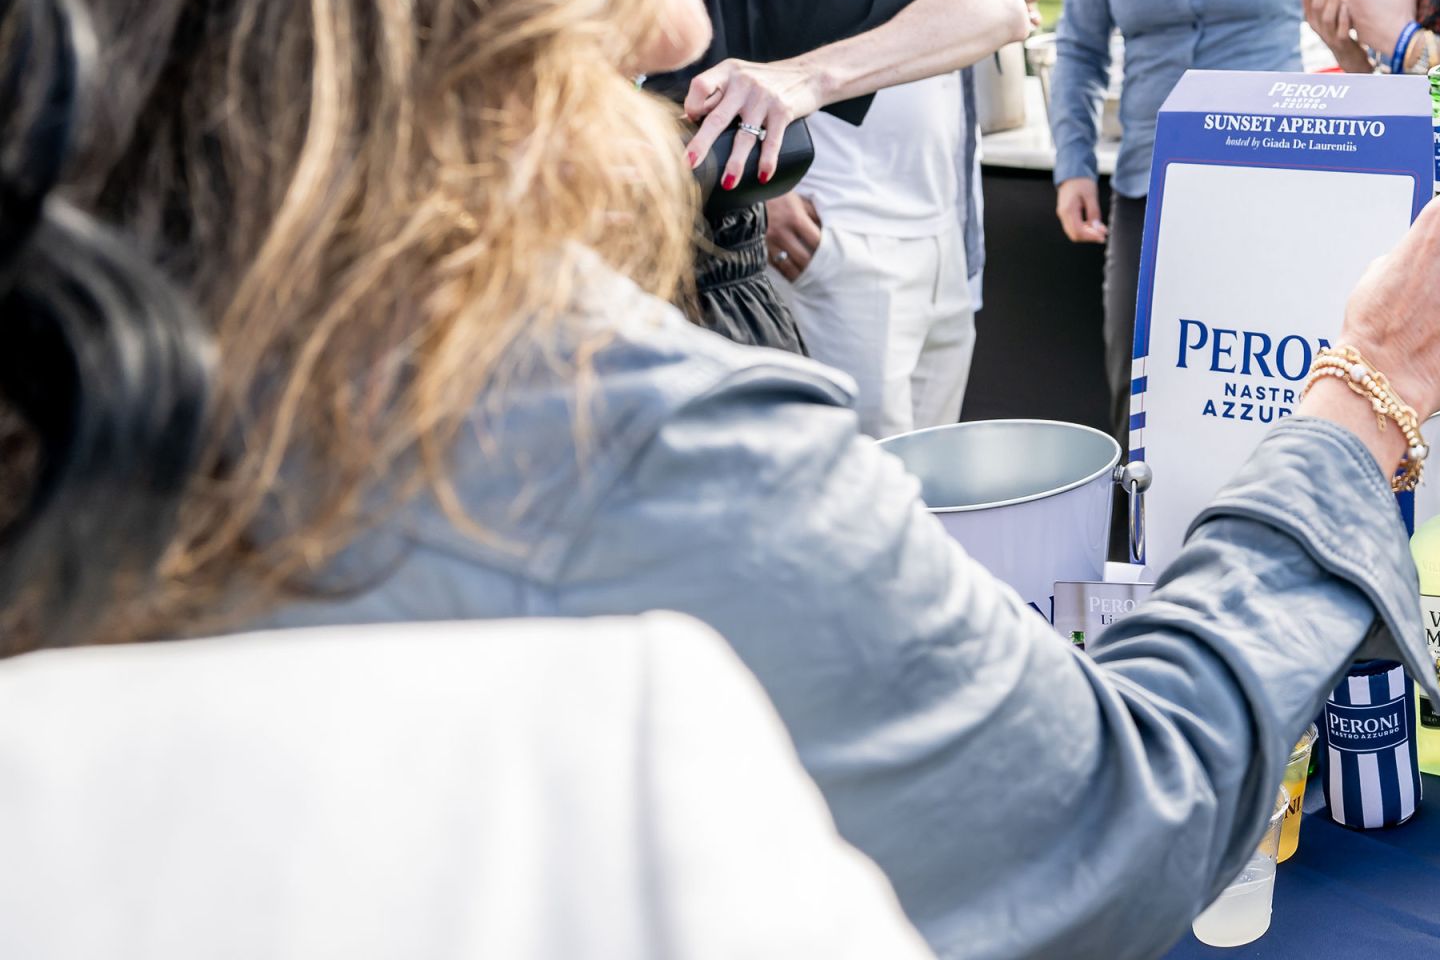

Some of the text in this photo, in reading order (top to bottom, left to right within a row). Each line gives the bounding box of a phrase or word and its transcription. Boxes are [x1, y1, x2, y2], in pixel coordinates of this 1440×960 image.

[1268, 82, 1351, 98] PERONI
[1272, 102, 1327, 110] AZZURRO
[1204, 114, 1386, 137] SUNSET APERITIVO
[1225, 136, 1357, 152] hosted by Giada De Laurentiis
[1176, 319, 1331, 381] PERO
[1224, 382, 1295, 404] NASTR
[1088, 596, 1136, 613] PERO
[1329, 712, 1398, 733] PERONI
[1331, 727, 1400, 740] NASTRO AZZURRO
